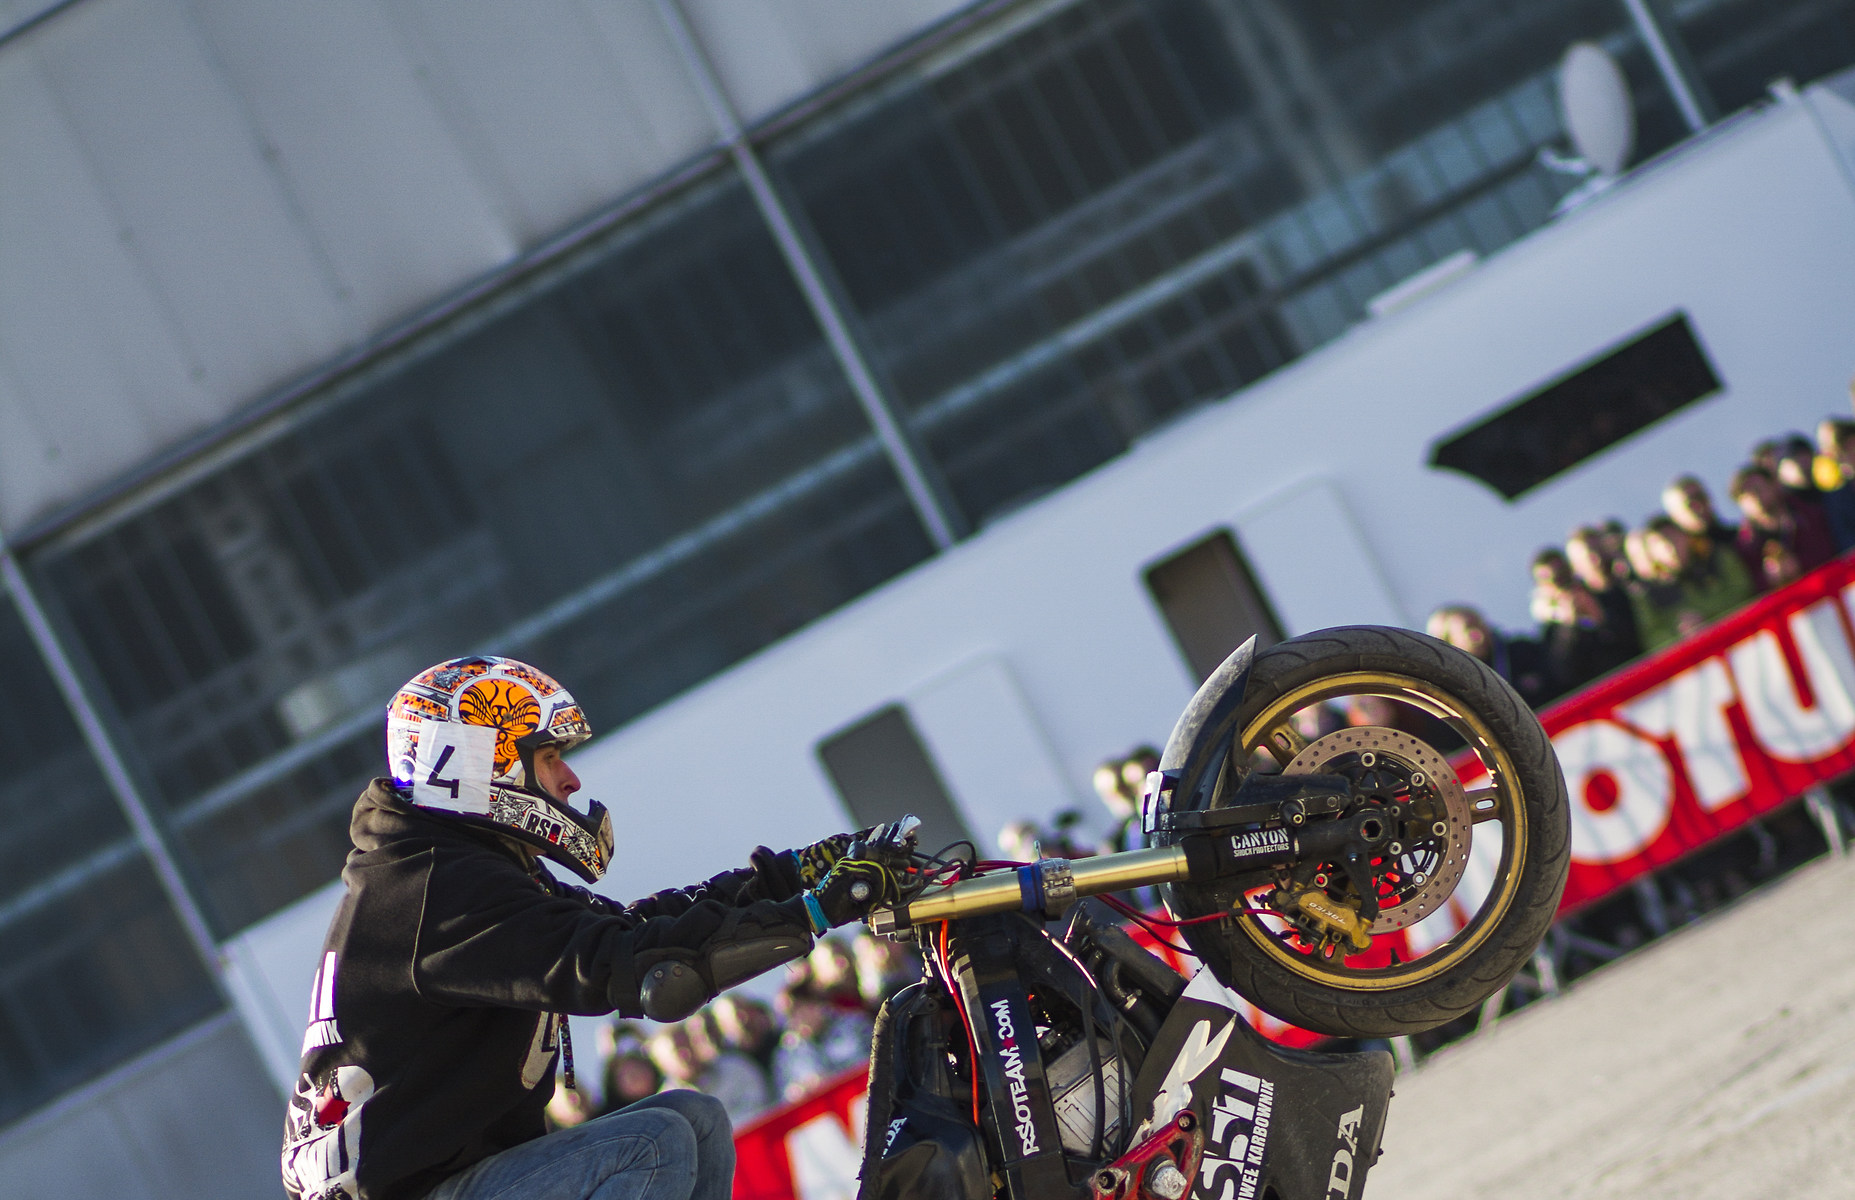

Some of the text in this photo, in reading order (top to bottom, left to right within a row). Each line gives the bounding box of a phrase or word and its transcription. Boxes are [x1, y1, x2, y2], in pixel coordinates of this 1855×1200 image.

[426, 744, 460, 799] 4
[1231, 827, 1289, 850] CANYON
[1233, 842, 1290, 858] SHOCK PROTECTORS
[1246, 1077, 1275, 1167] KARBOWNIK
